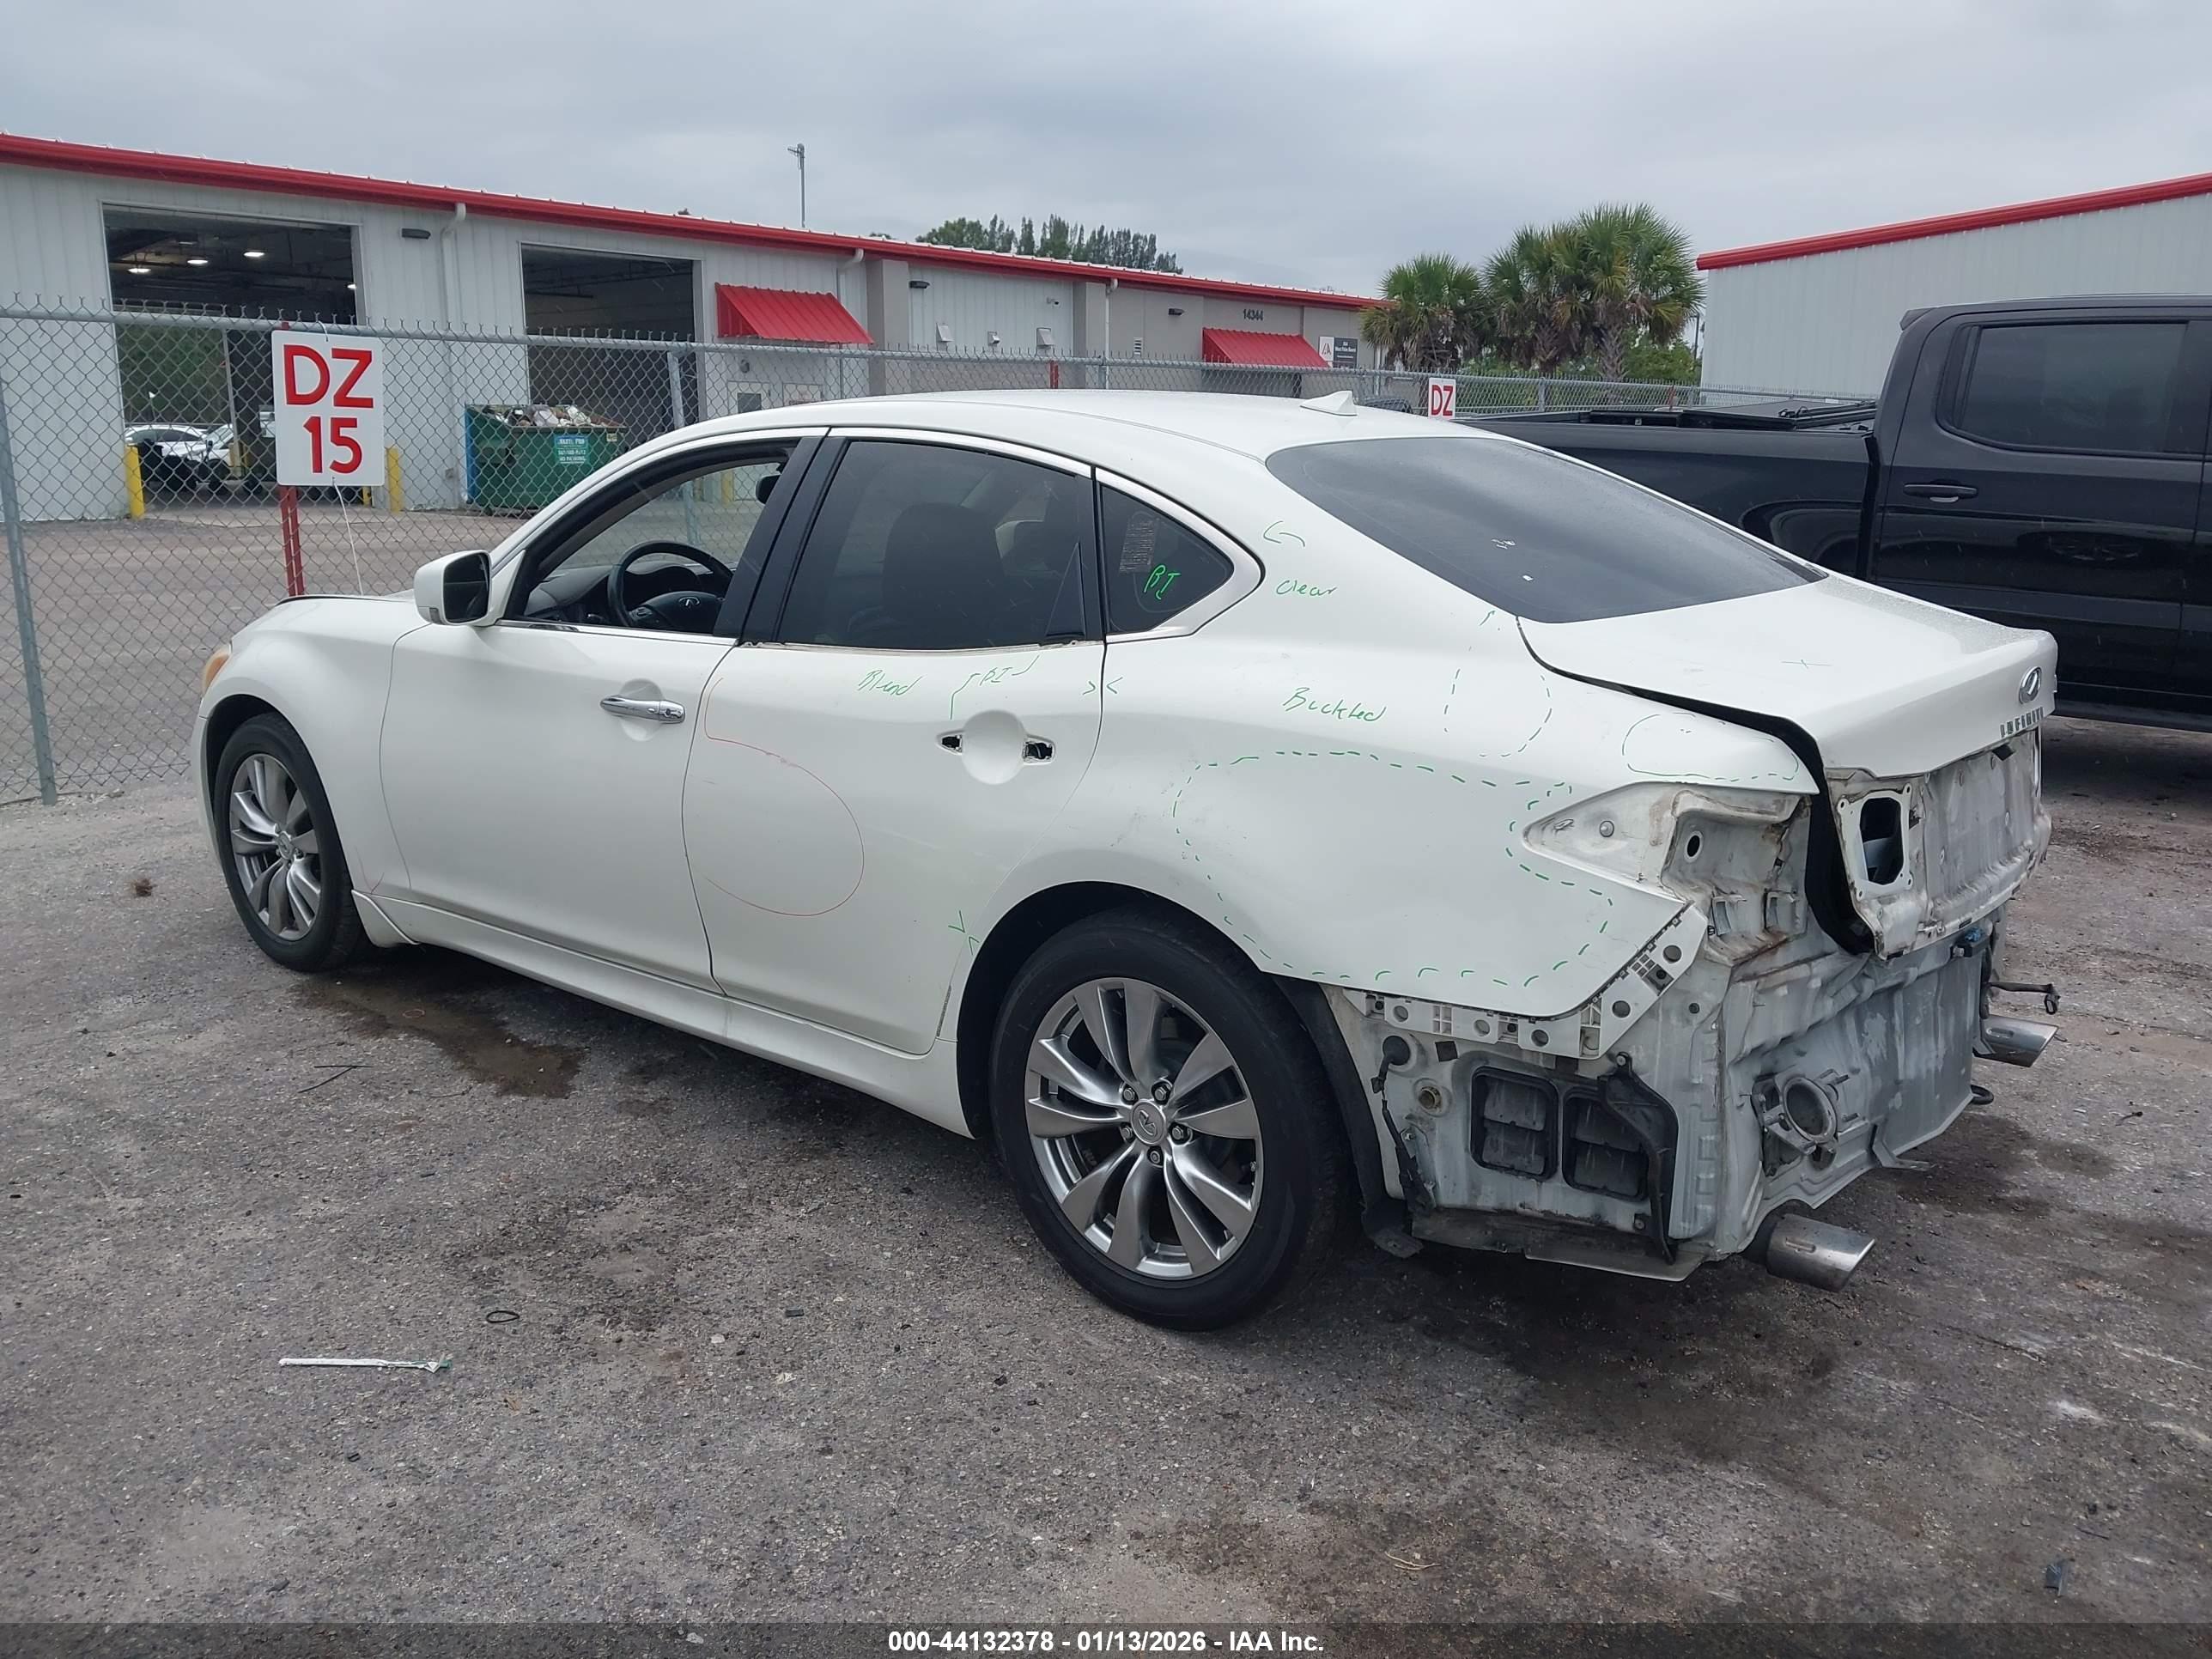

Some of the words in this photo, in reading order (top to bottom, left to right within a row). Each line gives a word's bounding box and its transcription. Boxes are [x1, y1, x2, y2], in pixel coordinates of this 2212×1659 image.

[1243, 308, 1264, 321] 14344
[283, 344, 374, 409] DZ
[1431, 384, 1454, 416] DZ
[303, 416, 363, 474] 15
